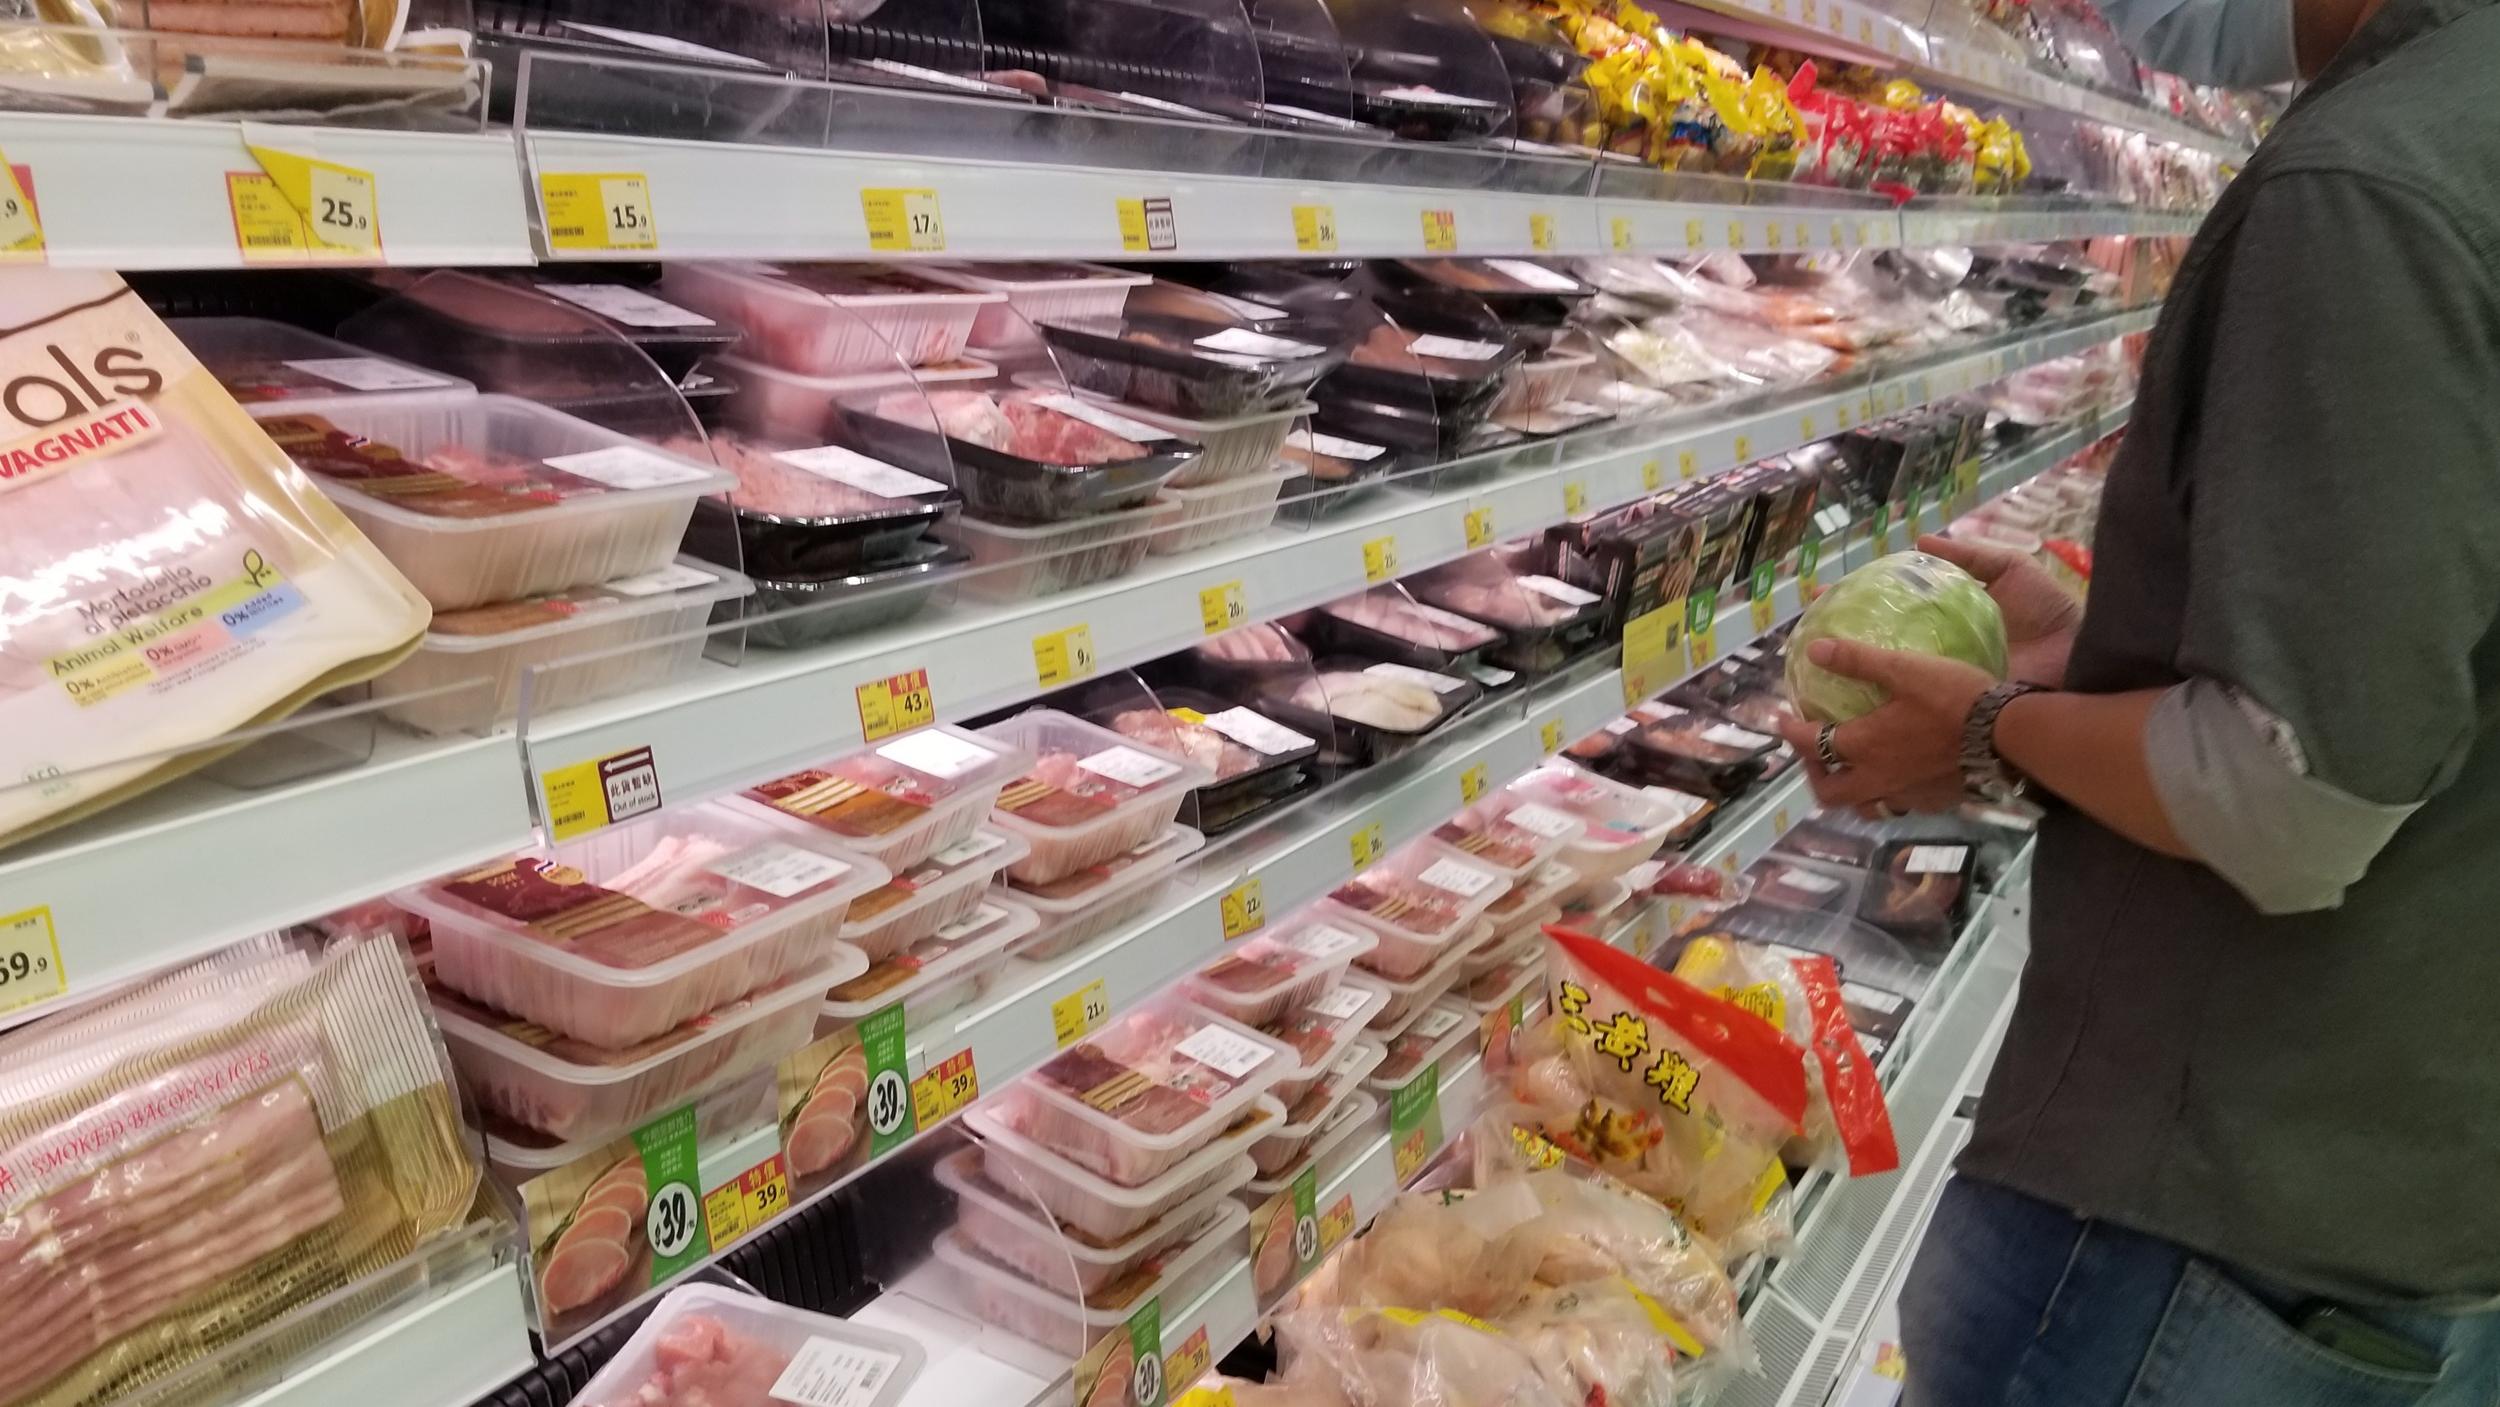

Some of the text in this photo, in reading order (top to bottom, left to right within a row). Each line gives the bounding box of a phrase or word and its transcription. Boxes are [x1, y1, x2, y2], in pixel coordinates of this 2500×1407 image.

[321, 196, 367, 230] 25.9
[613, 204, 648, 229] 15.9
[76, 566, 192, 621] Mortadella
[222, 610, 249, 627] 0%
[52, 638, 122, 676] Animal
[124, 606, 204, 646] Welfare
[146, 645, 174, 661] 0%
[65, 677, 95, 695] 0%
[613, 801, 627, 814] Out
[637, 791, 656, 807] stock
[32, 1049, 271, 1176] SMOKED BACON SLICES
